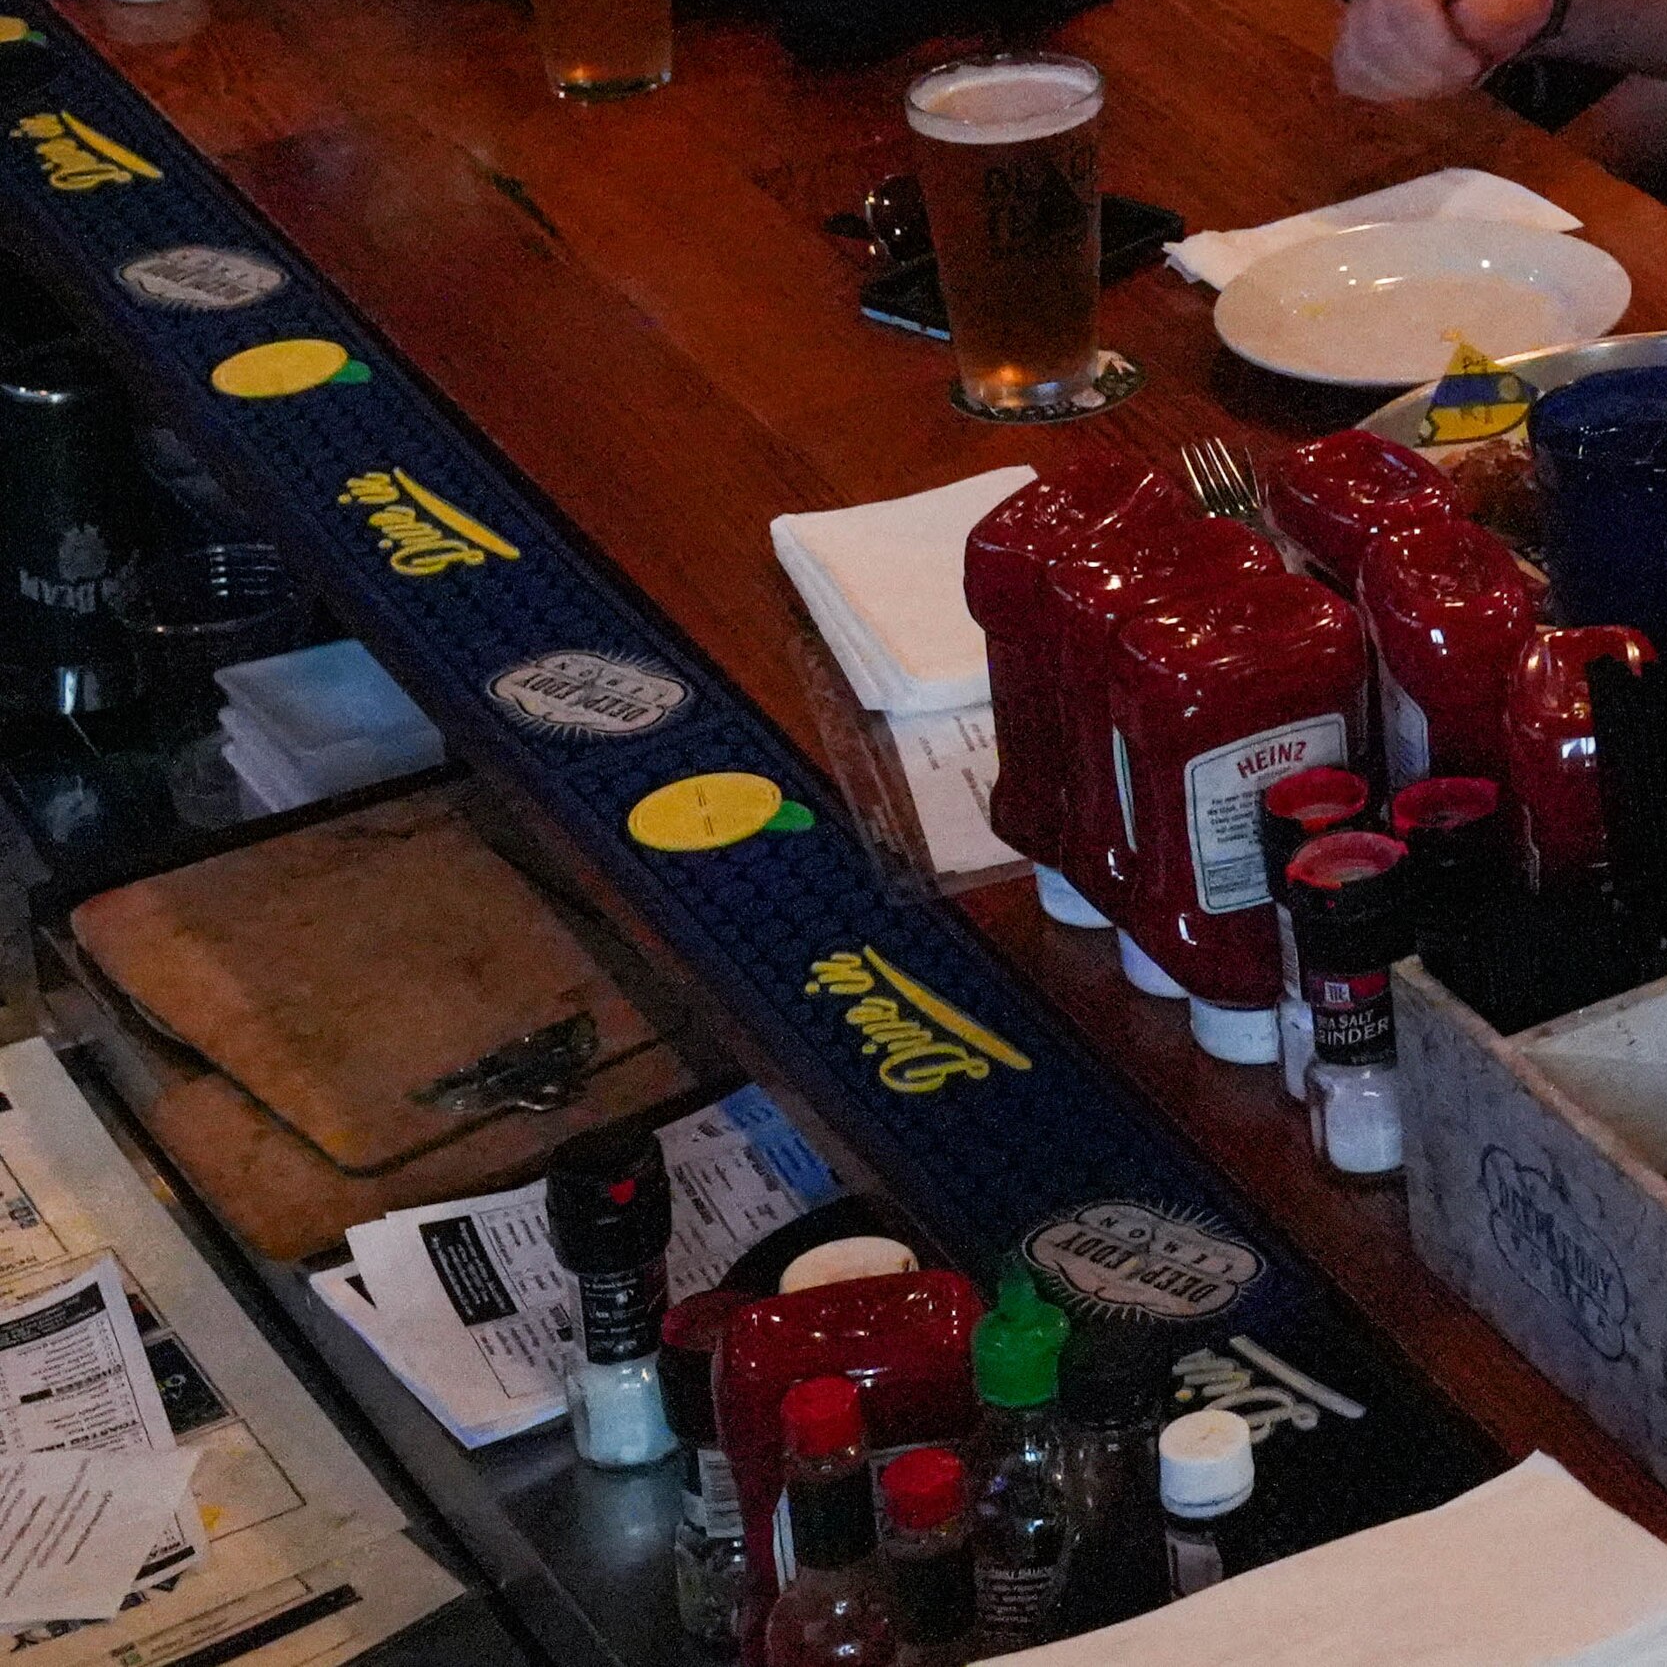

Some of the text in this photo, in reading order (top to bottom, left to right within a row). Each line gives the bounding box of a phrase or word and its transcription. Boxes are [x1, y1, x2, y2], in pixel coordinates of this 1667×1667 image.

[369, 504, 486, 578] Dive
[1237, 741, 1306, 779] HEINZ
[805, 949, 989, 1095] Dive in
[1315, 1018, 1389, 1046] RINDER
[1339, 1009, 1374, 1030] SALT
[1052, 1231, 1218, 1305] DEEP EDDY
[1100, 1216, 1234, 1275] LEMON
